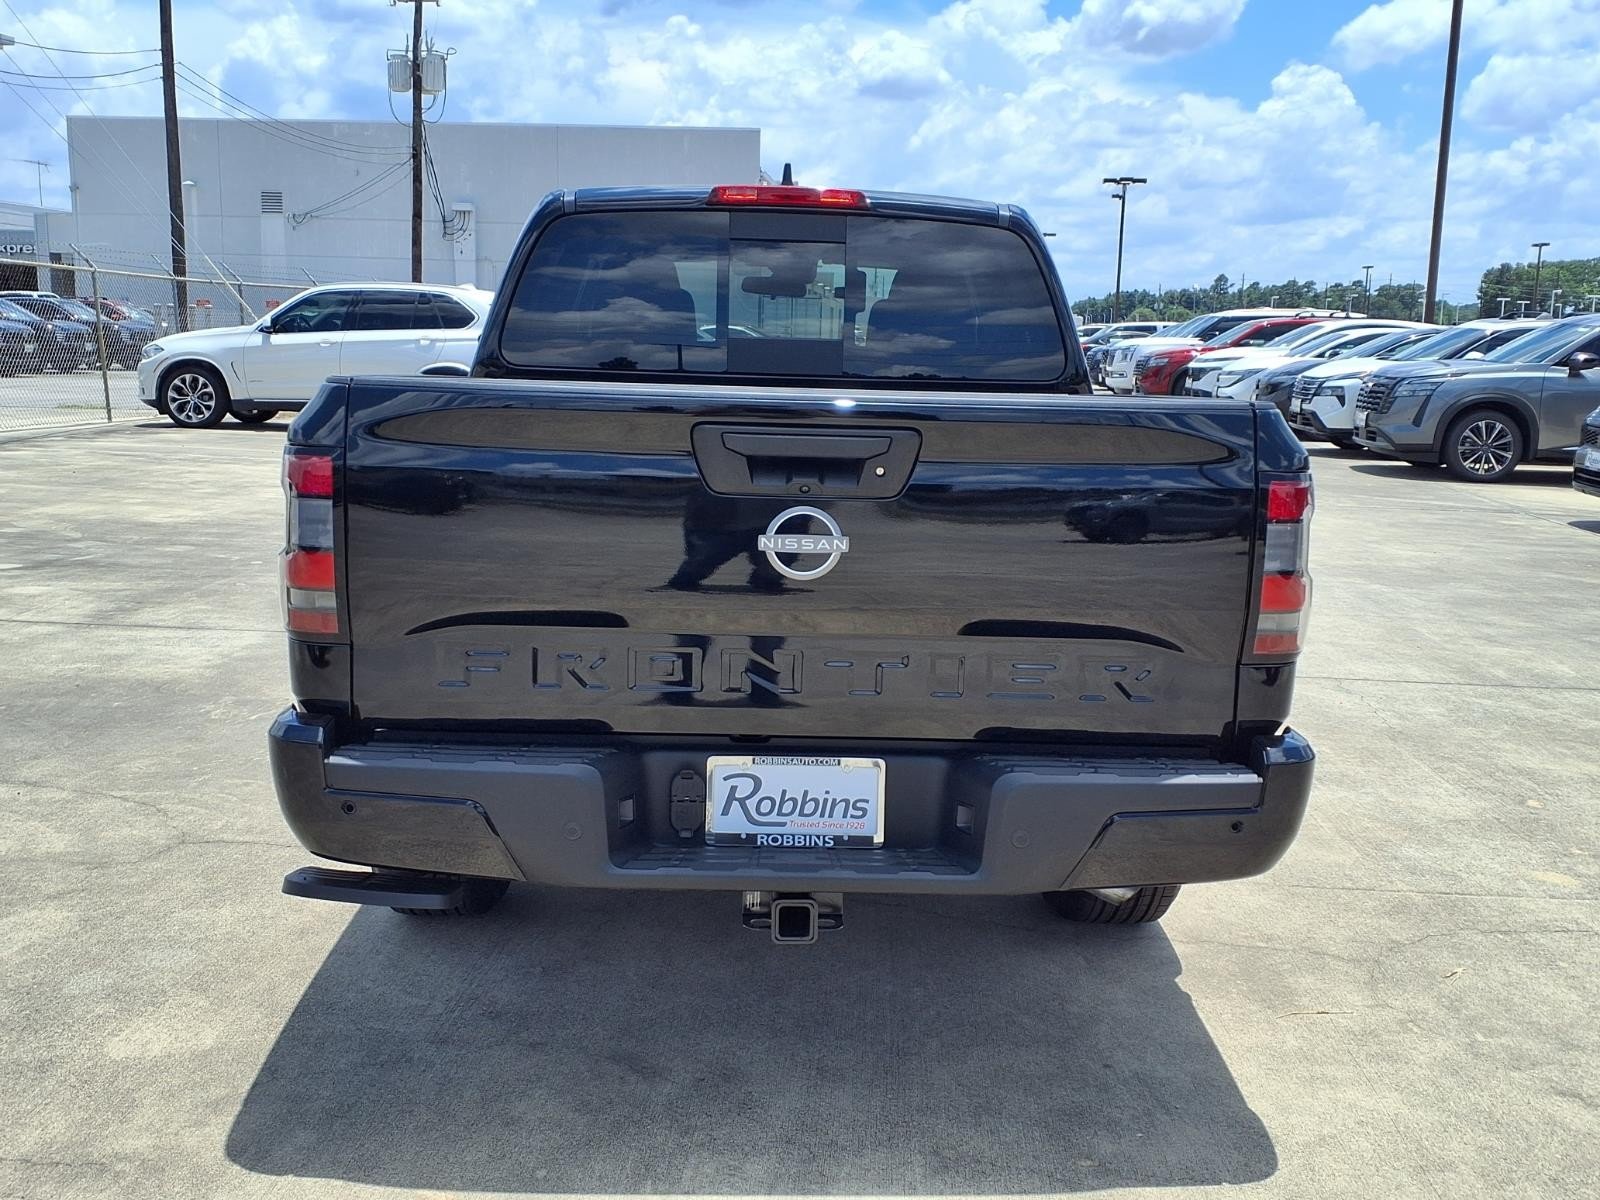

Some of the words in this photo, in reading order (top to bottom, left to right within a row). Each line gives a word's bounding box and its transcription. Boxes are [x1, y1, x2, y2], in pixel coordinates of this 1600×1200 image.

[760, 537, 847, 550] NISSAN
[436, 645, 1156, 702] FRONTIER
[754, 757, 839, 767] ROBBINSAUTO.COM
[720, 772, 870, 828] Robbins
[789, 820, 820, 830] Trusted
[821, 821, 845, 830] Since
[846, 821, 866, 830] 1928
[756, 834, 835, 848] ROBBINS
